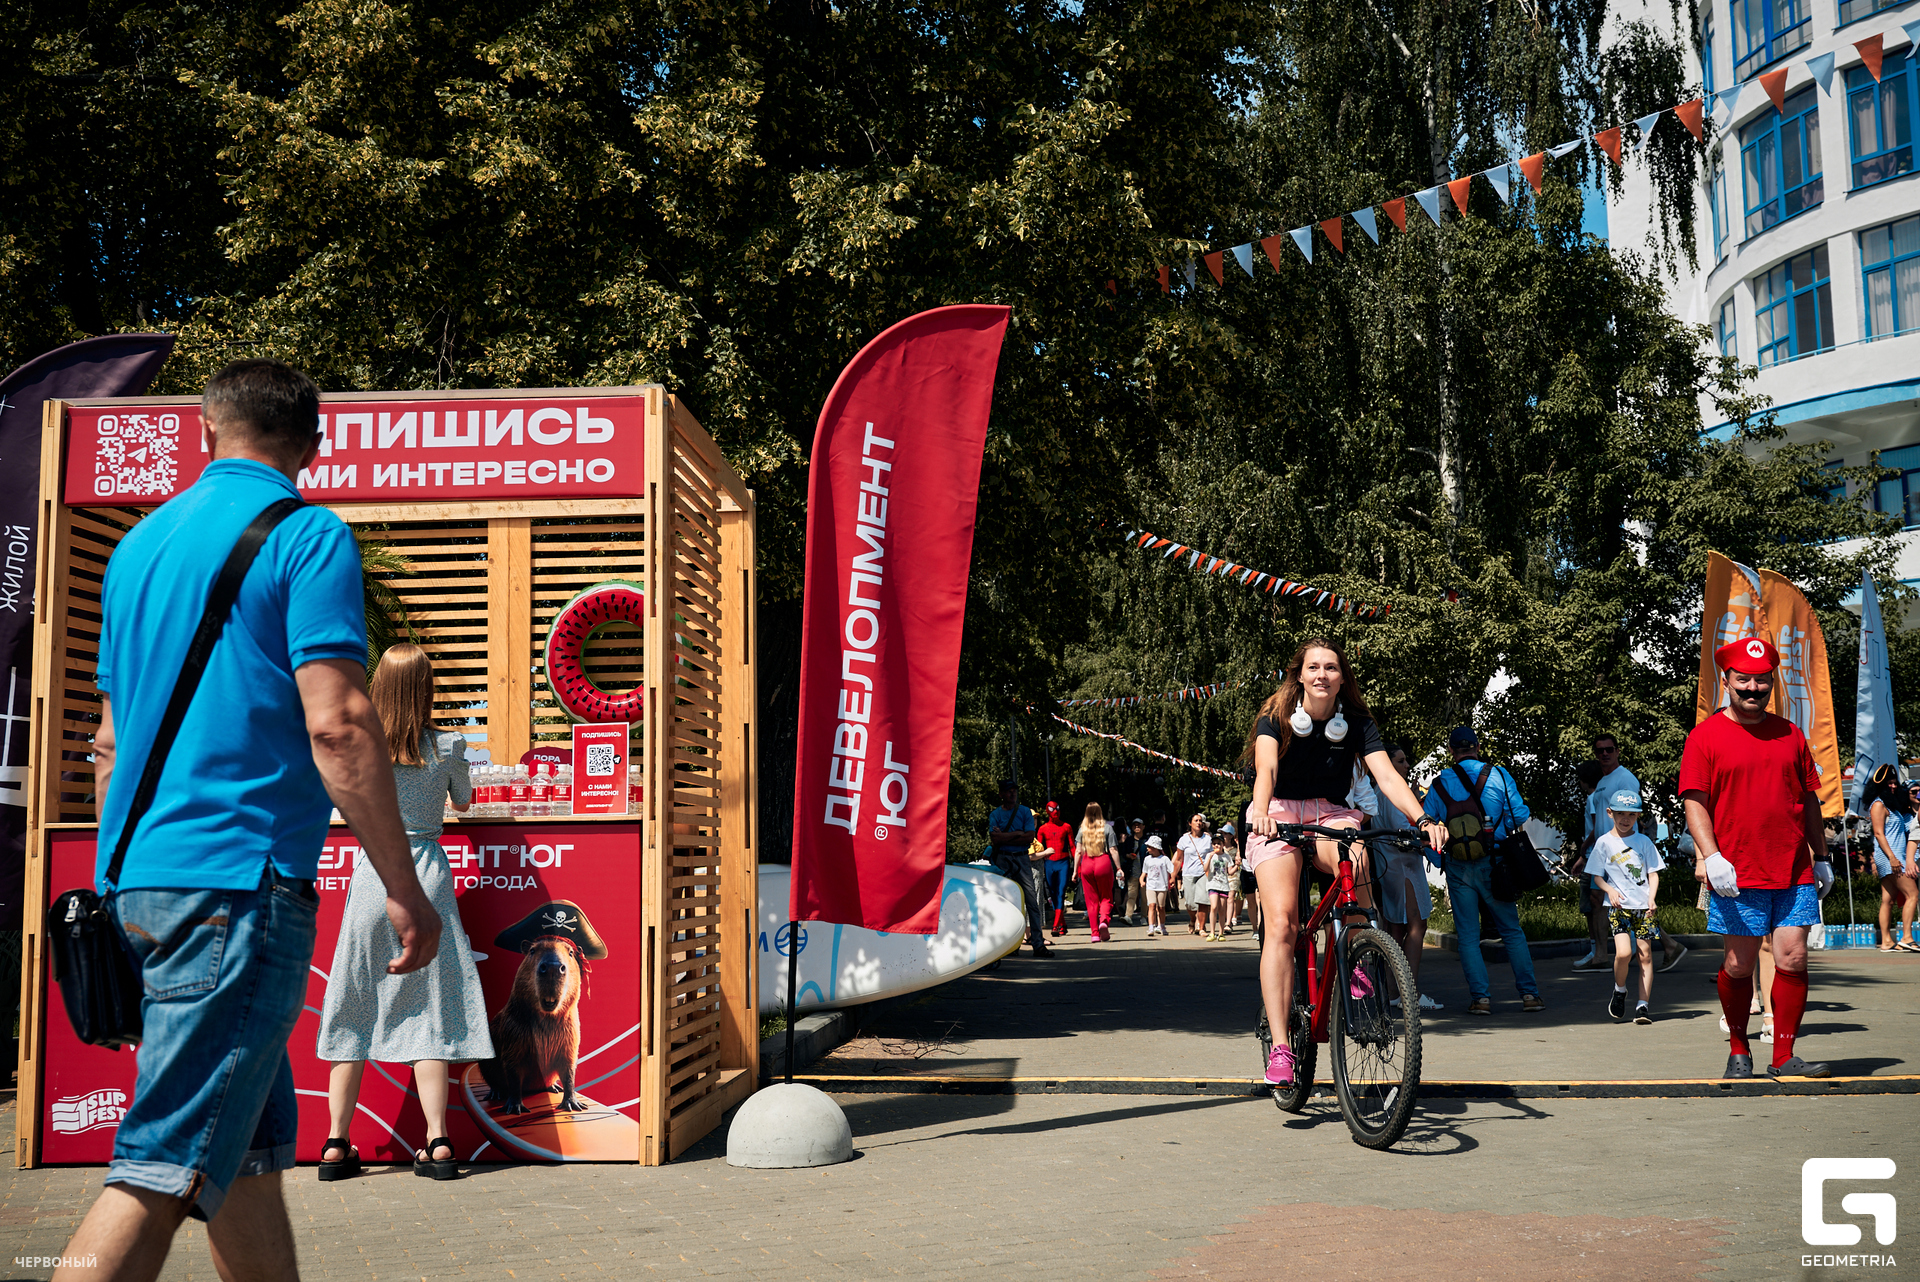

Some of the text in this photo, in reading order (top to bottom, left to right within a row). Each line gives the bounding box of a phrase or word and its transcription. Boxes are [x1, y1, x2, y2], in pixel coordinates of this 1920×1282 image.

[373, 458, 616, 487] ИНТЕРЕСНО
[0, 525, 31, 613] ЖИЛОЙ
[824, 421, 895, 836] ДЕВЕЛОПМЕНТ
[581, 731, 622, 739] ПОДПИШИСЬ
[453, 875, 538, 891] ГОРОДА
[88, 1091, 127, 1110] SUP
[88, 1105, 127, 1125] FEST
